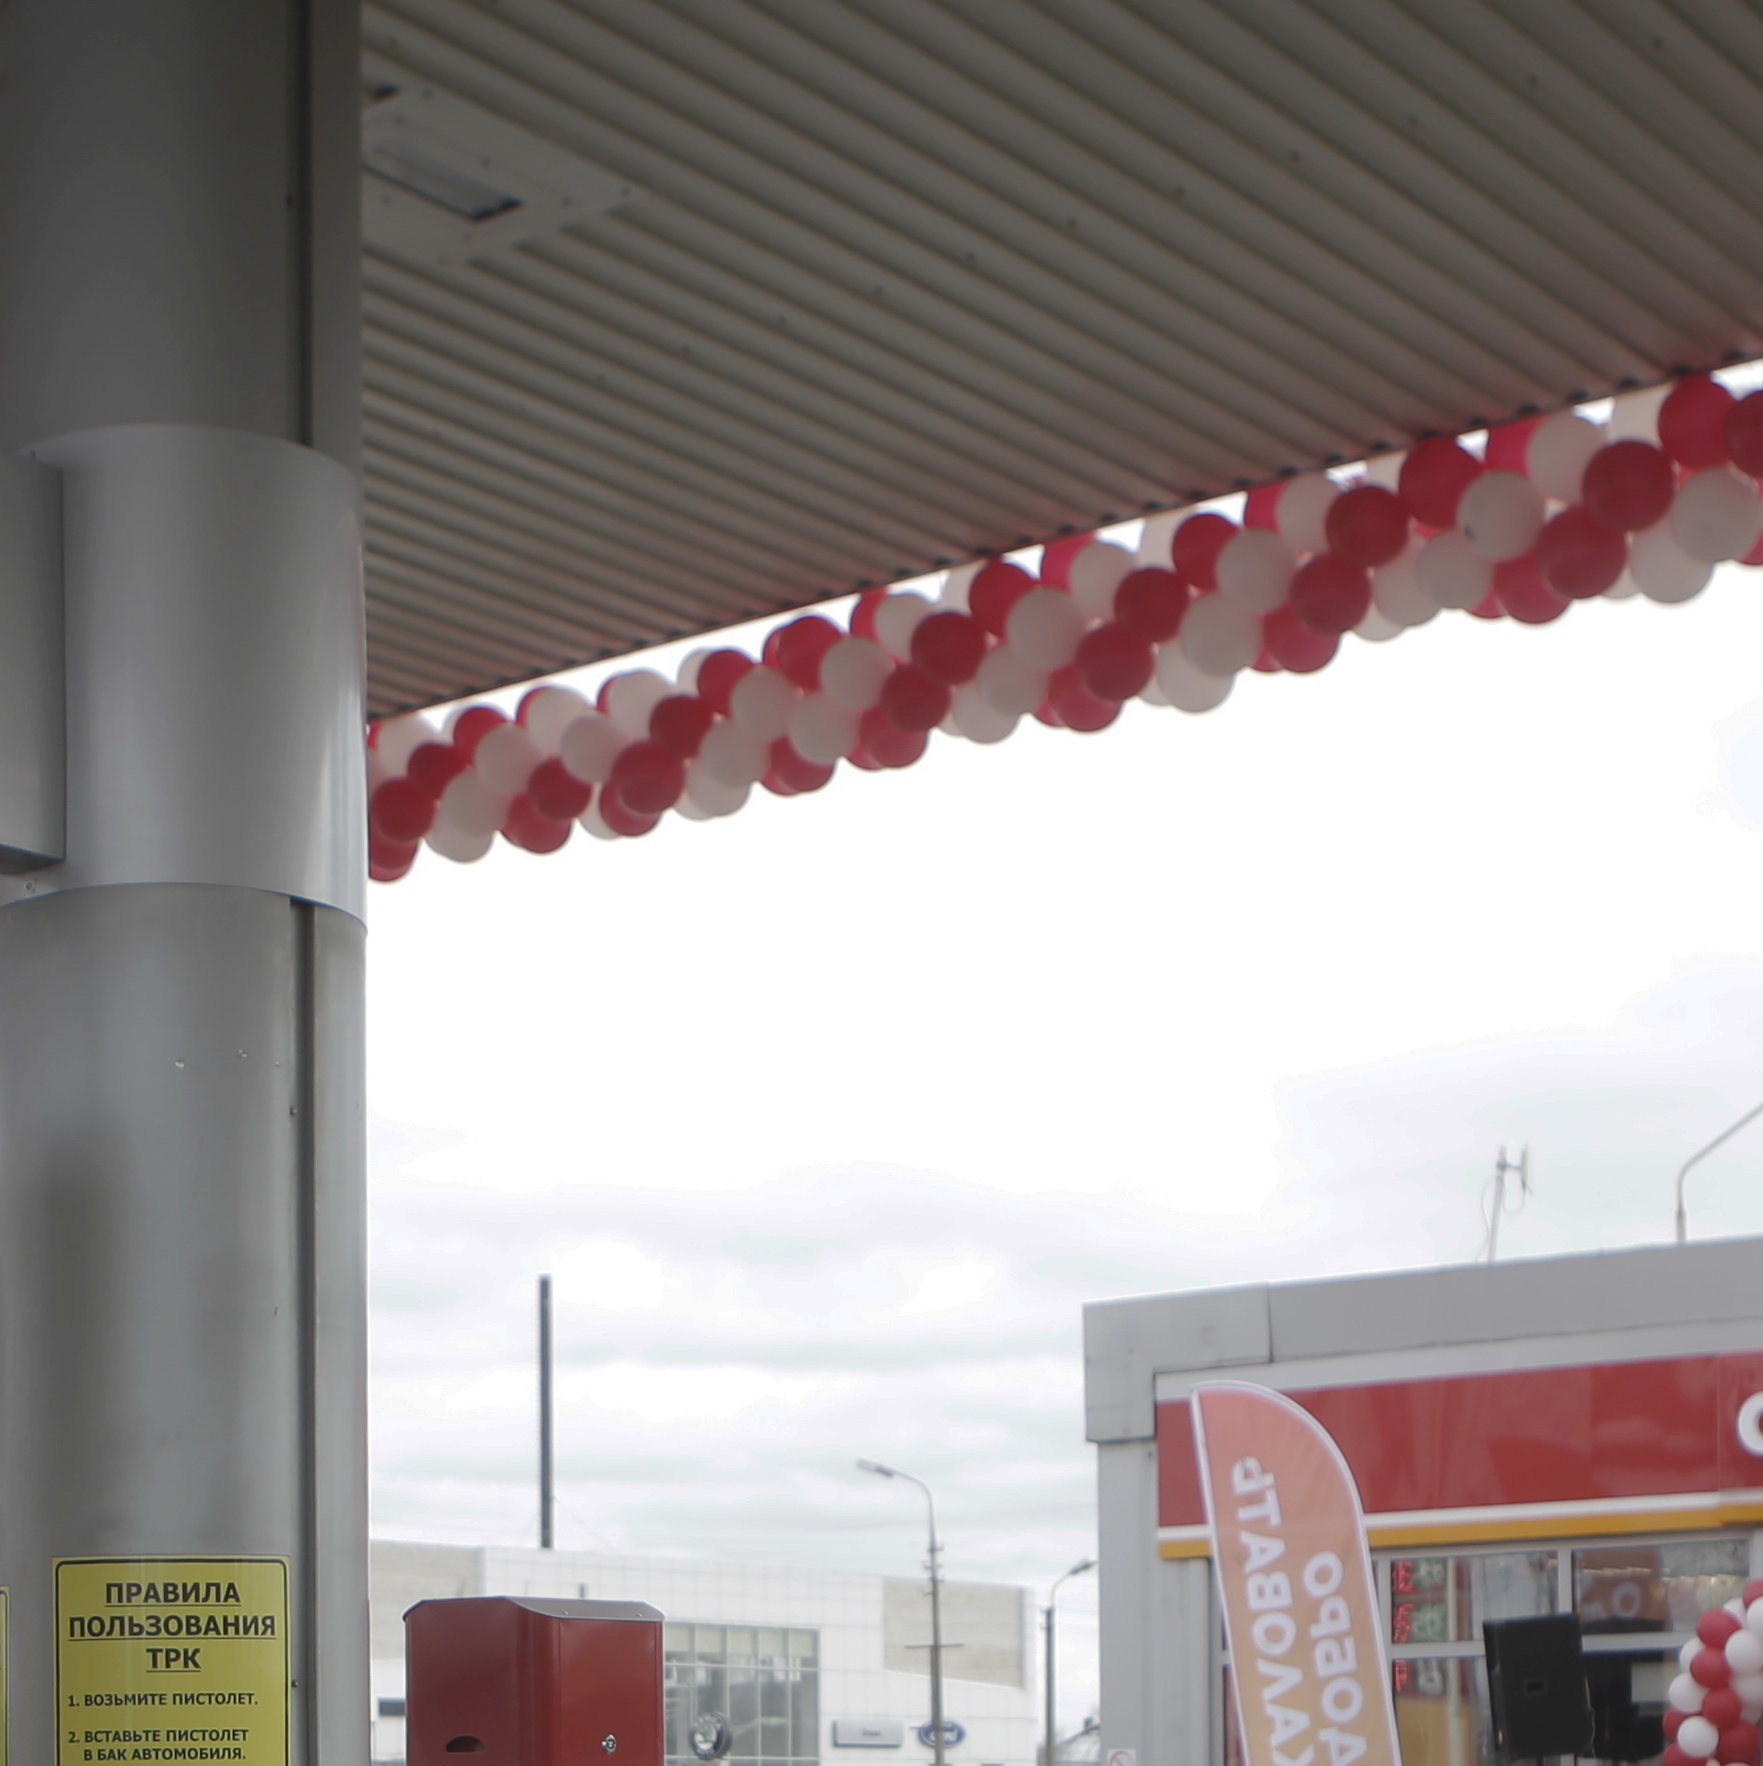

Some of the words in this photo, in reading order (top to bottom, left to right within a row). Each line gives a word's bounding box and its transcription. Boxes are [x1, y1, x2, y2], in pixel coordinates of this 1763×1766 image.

[104, 1582, 241, 1604] ПРАВИЛА
[68, 1614, 276, 1638] ПОЛЬЗОВАНИЯ
[147, 1648, 201, 1669] ТРК
[68, 1695, 80, 1706] 1.
[84, 1693, 167, 1706] ВОЗЬМИТЕ
[172, 1693, 258, 1705] ПИСТОЛЕТ.
[68, 1731, 80, 1743] 2.
[84, 1730, 161, 1743] ВСТАВЬТЕ
[166, 1729, 249, 1742] ПИСТОЛЕТ
[84, 1749, 93, 1761] В
[97, 1749, 127, 1761] БАК
[131, 1748, 247, 1760] АВТОМОБИЛЯ.
